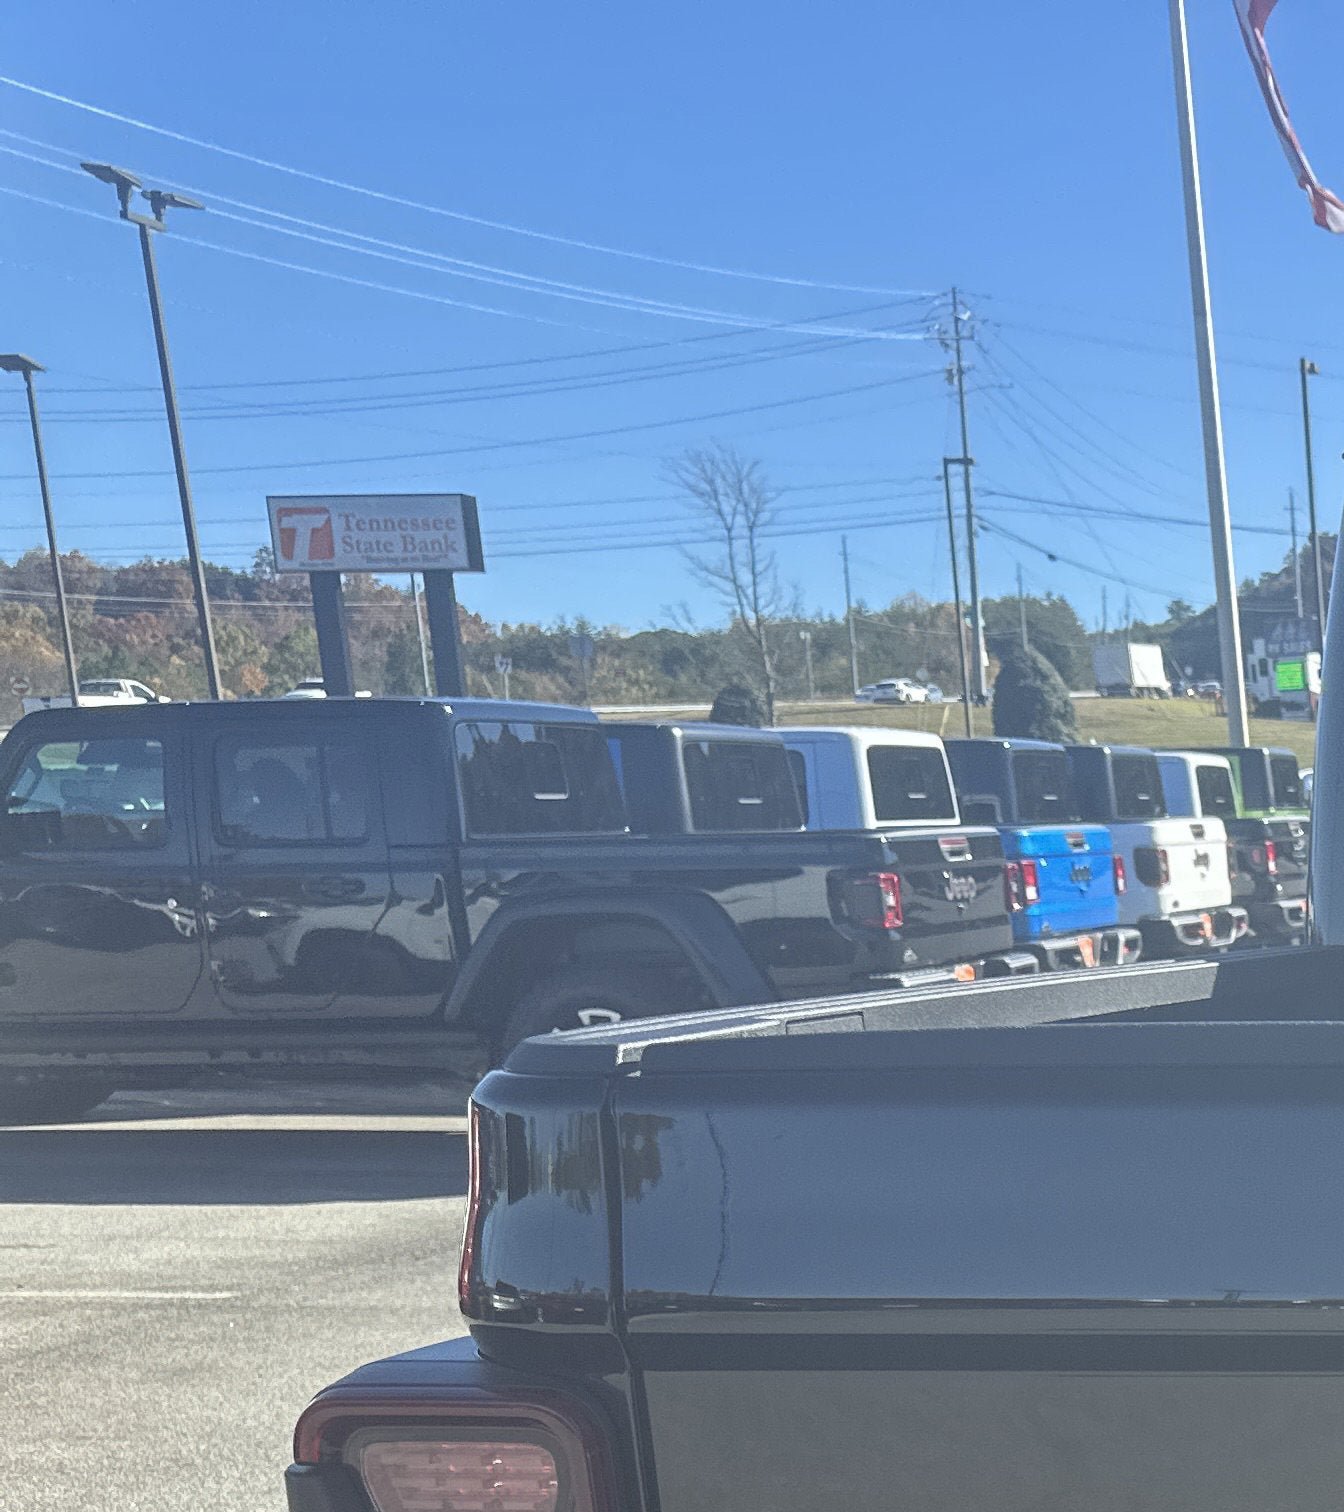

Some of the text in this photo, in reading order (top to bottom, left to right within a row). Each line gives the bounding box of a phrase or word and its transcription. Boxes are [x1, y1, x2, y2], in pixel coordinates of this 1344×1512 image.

[338, 513, 457, 532] Tennessee
[341, 534, 458, 554] State Bank
